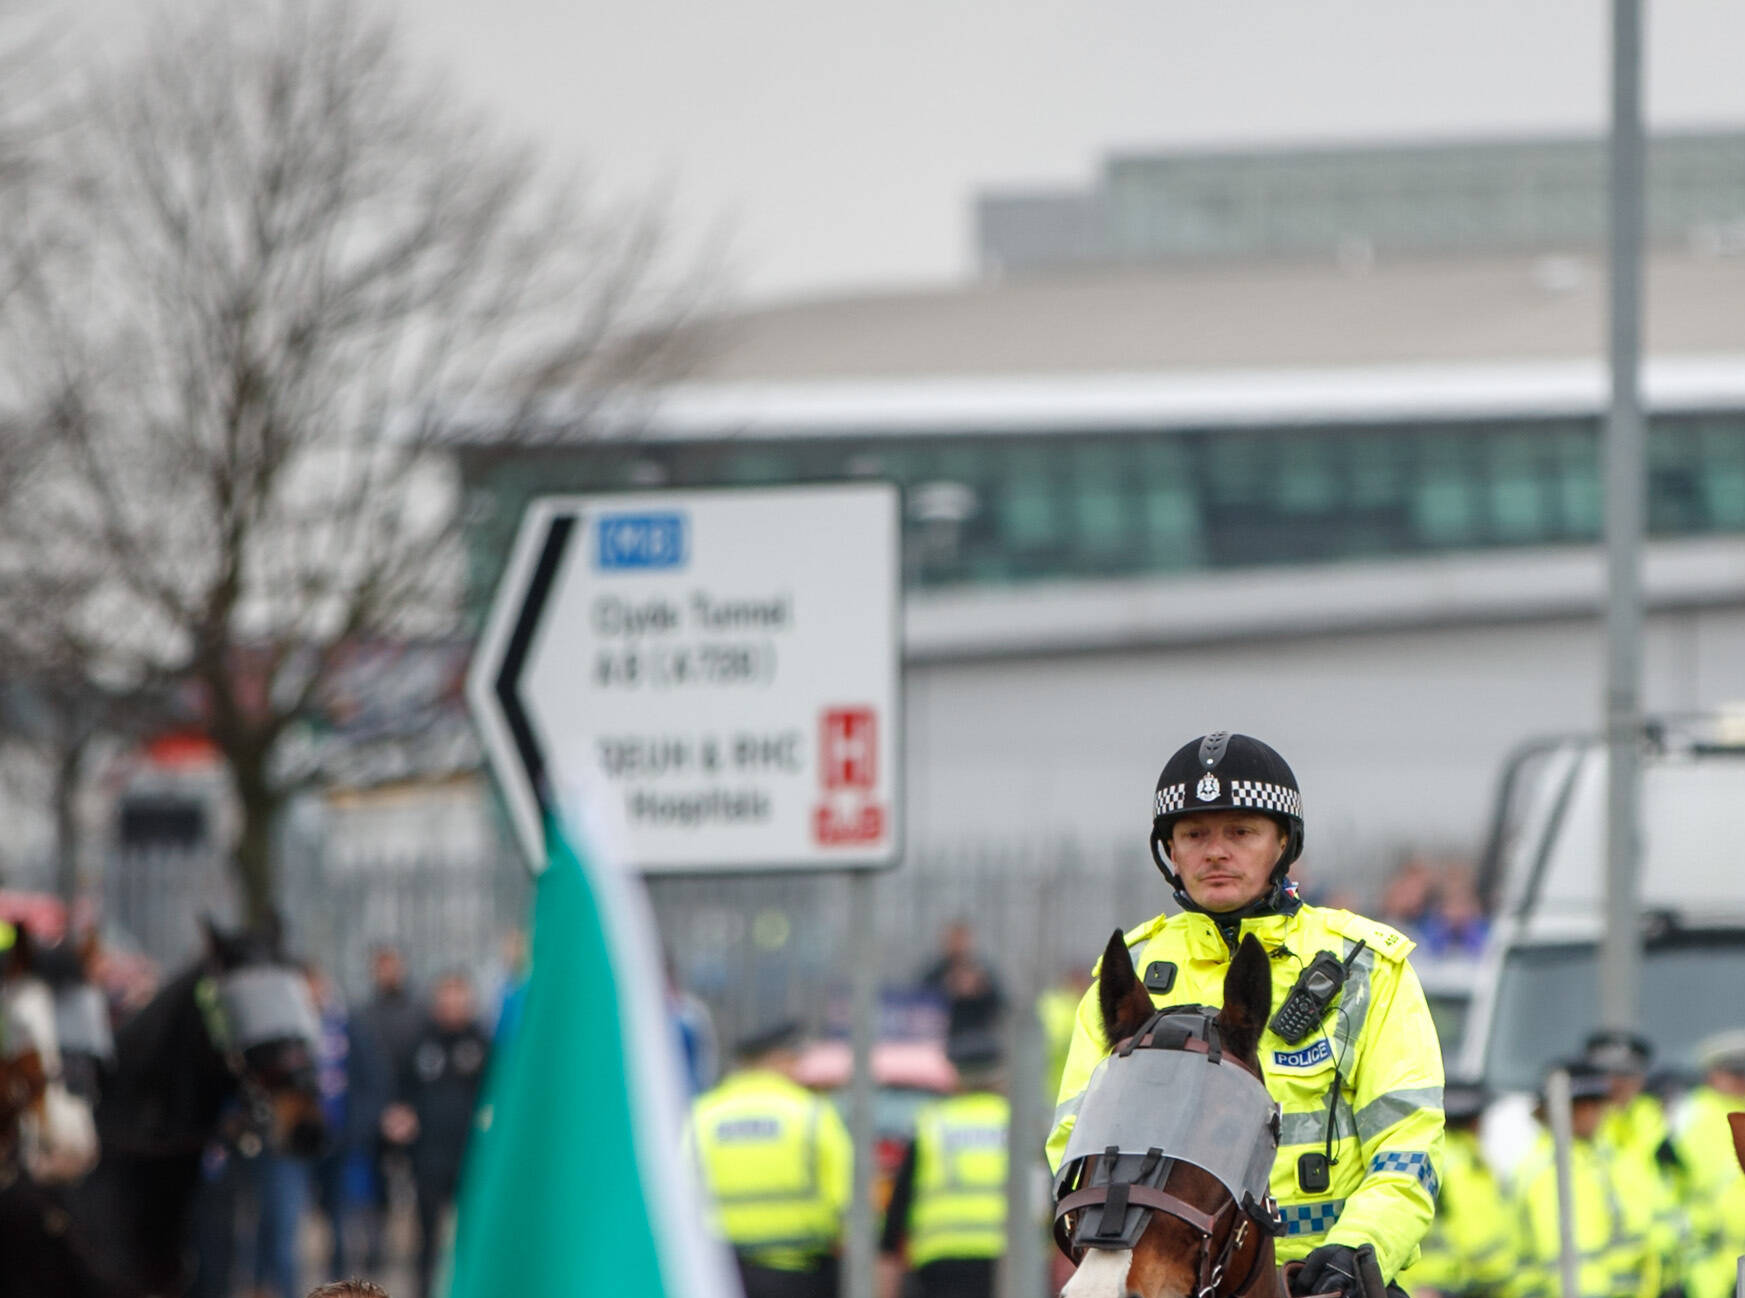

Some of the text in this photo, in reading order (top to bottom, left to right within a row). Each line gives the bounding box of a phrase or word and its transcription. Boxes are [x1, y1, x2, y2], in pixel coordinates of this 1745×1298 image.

[593, 589, 791, 638] Clyde Tunnel
[1277, 1041, 1329, 1067] POLICE
